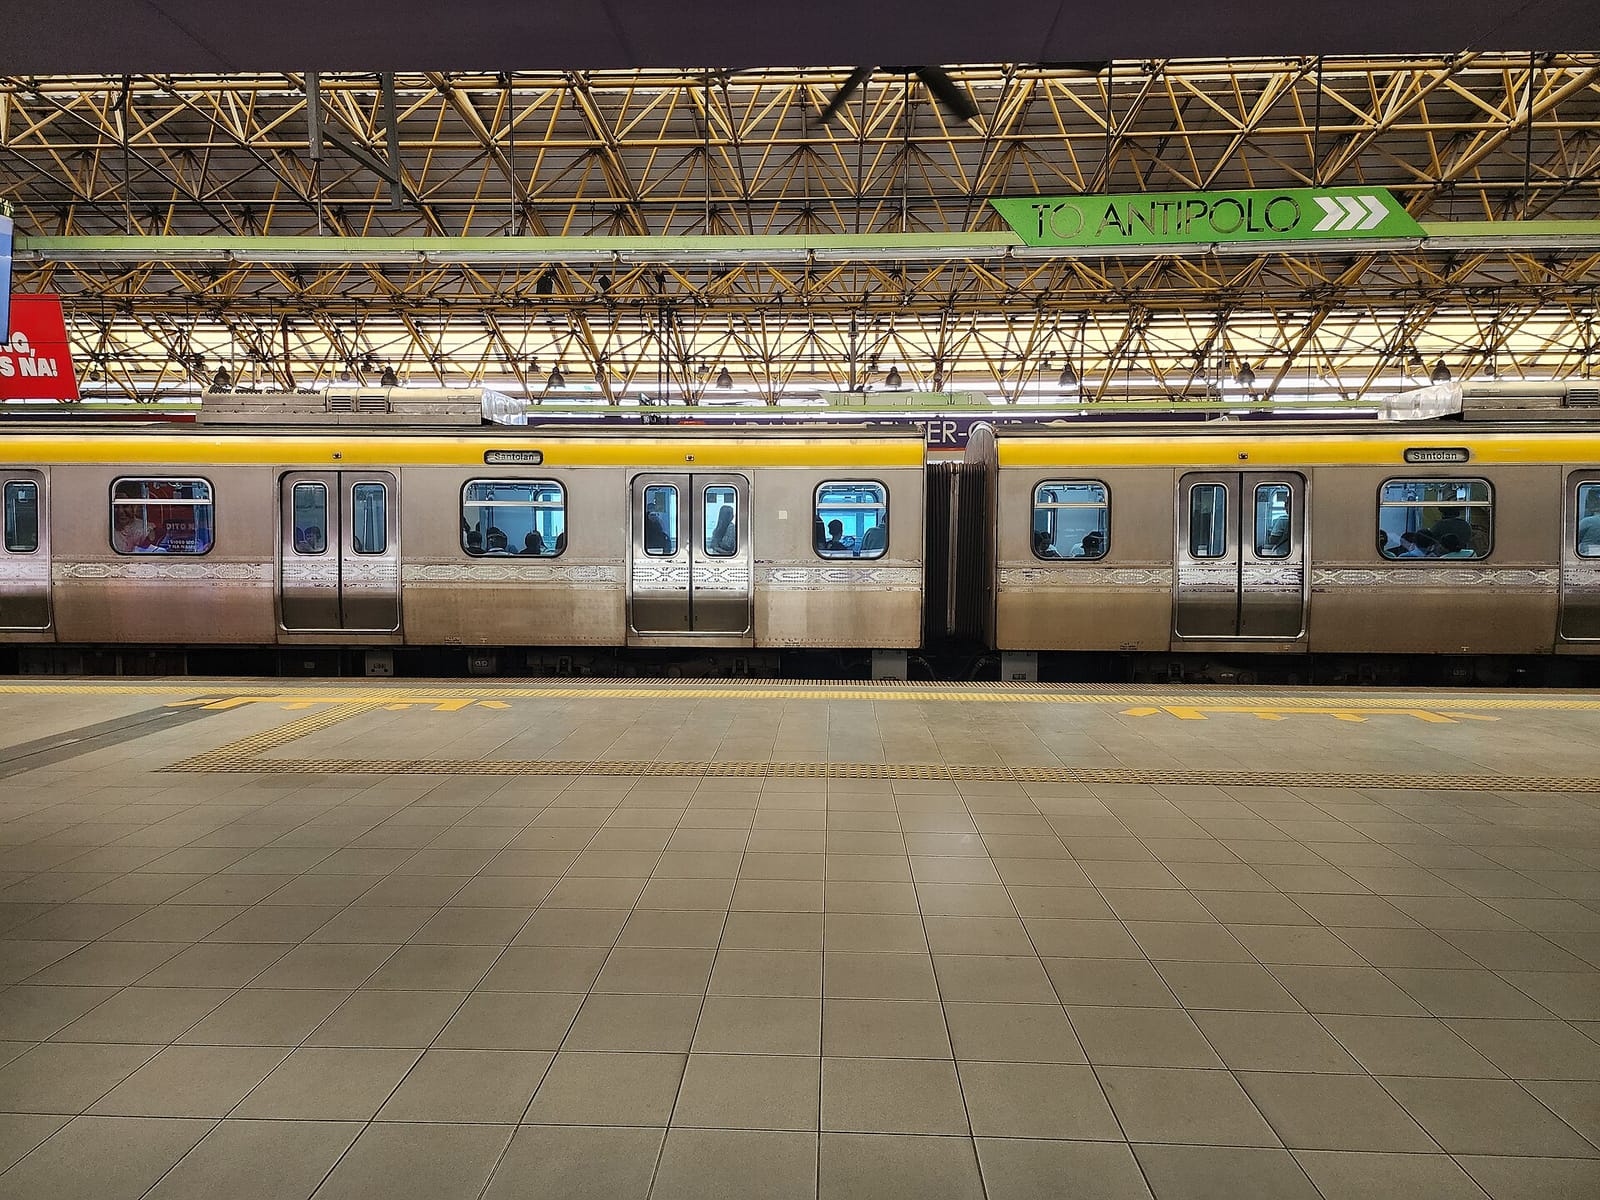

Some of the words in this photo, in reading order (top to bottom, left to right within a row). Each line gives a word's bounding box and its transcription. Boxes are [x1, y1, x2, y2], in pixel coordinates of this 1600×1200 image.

[1031, 203, 1084, 239] TO
[1095, 196, 1300, 237] ANTIPOLO
[17, 357, 58, 377] NA!
[494, 452, 534, 461] Santolan
[1413, 451, 1457, 460] Santolan
